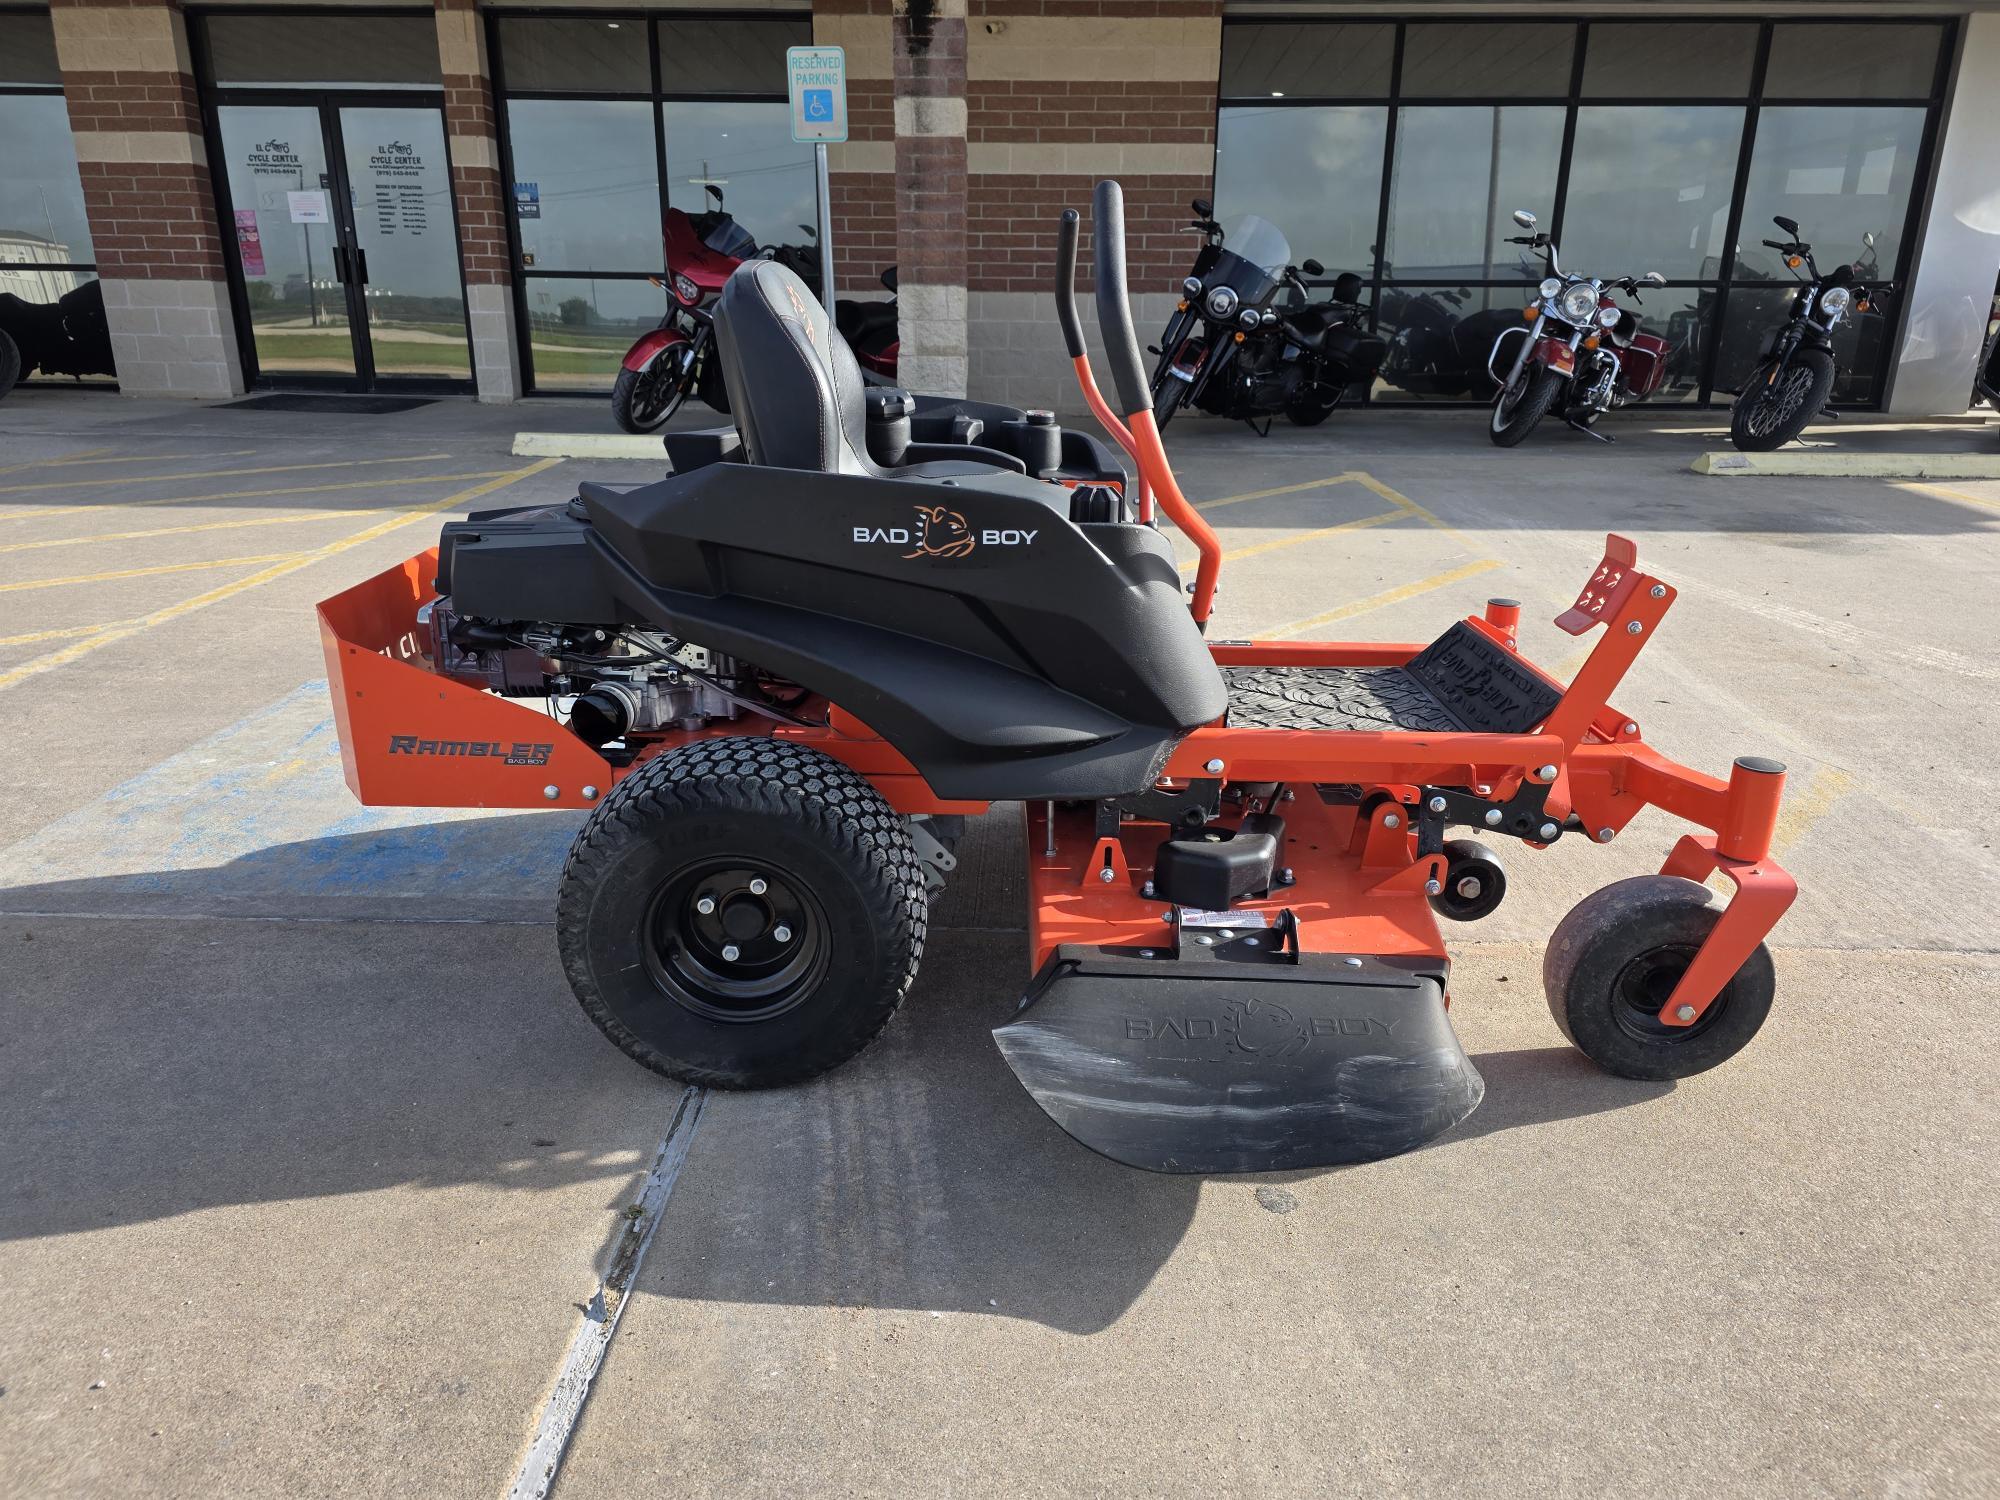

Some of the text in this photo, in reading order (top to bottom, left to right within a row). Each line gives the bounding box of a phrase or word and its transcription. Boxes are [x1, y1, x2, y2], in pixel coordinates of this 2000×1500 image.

[792, 56, 841, 69] RESERVED
[795, 73, 839, 85] PARKING
[255, 144, 264, 152] EL
[378, 145, 386, 154] EL
[248, 154, 299, 163] CYCLE CENTER
[371, 156, 421, 164] CYCLE CENTER
[853, 527, 1038, 545] BAD BOY
[388, 735, 554, 758] RAMBLER
[1126, 1015, 1401, 1040] BAD BOY
